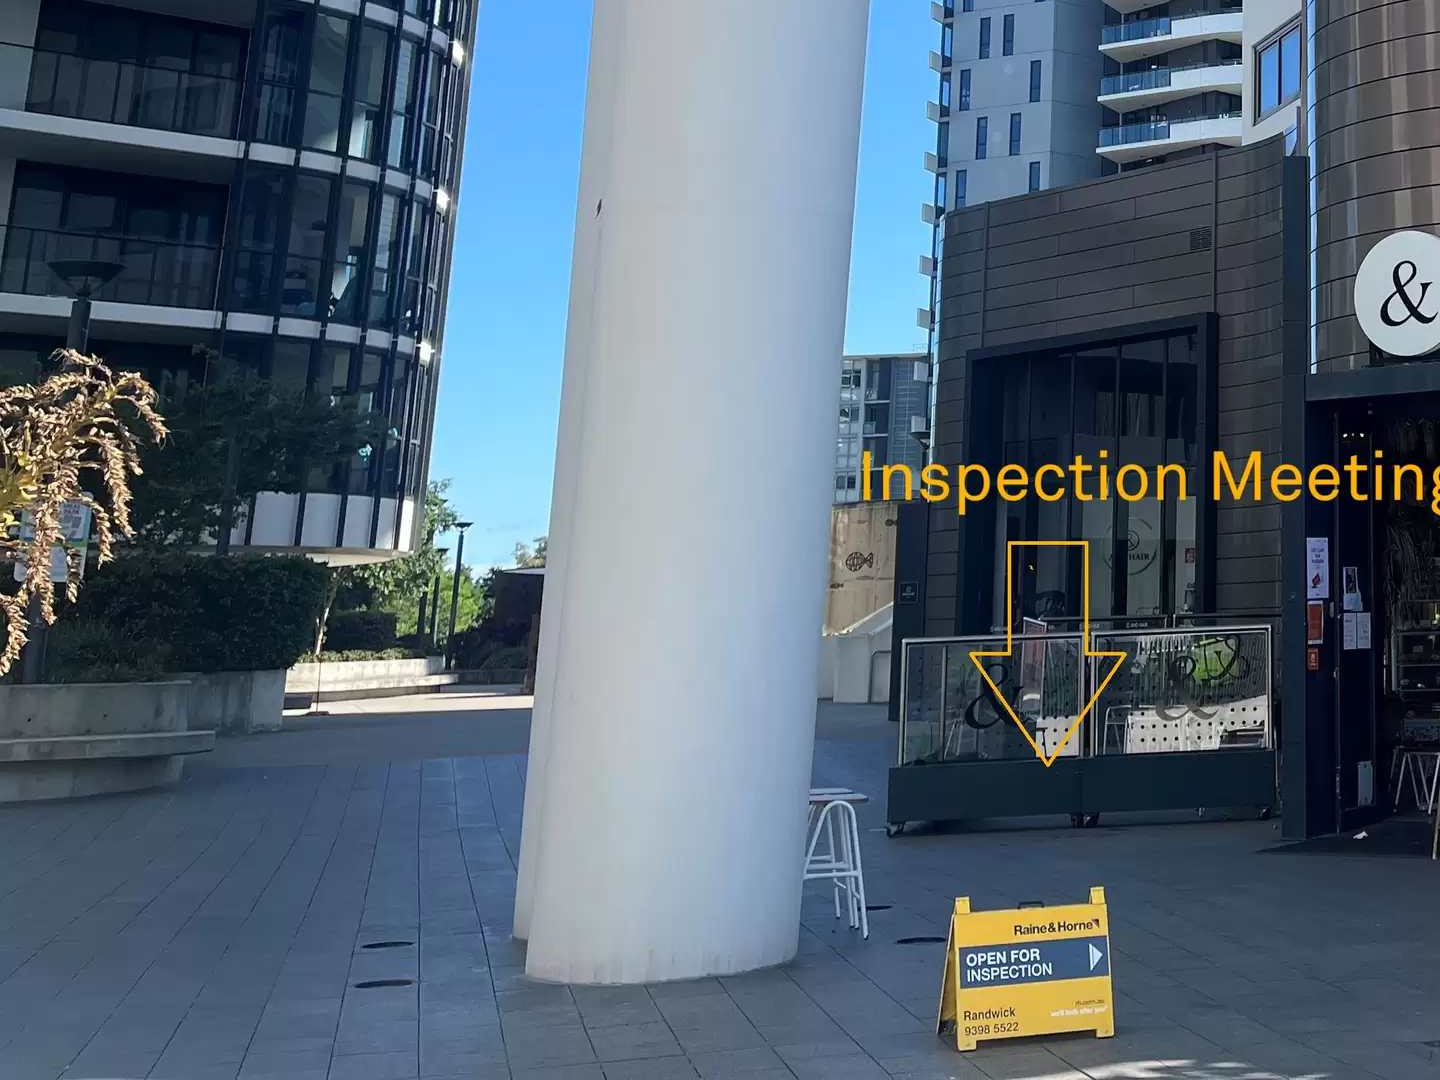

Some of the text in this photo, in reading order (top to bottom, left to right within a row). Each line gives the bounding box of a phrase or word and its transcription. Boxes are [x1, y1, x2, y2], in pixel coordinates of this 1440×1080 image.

[1379, 260, 1439, 327] &
[965, 948, 1040, 967] OPEN FOR
[966, 963, 1052, 983] INSPECTION
[964, 1007, 1016, 1021] Randwick
[964, 1022, 1019, 1037] 9398 5522
